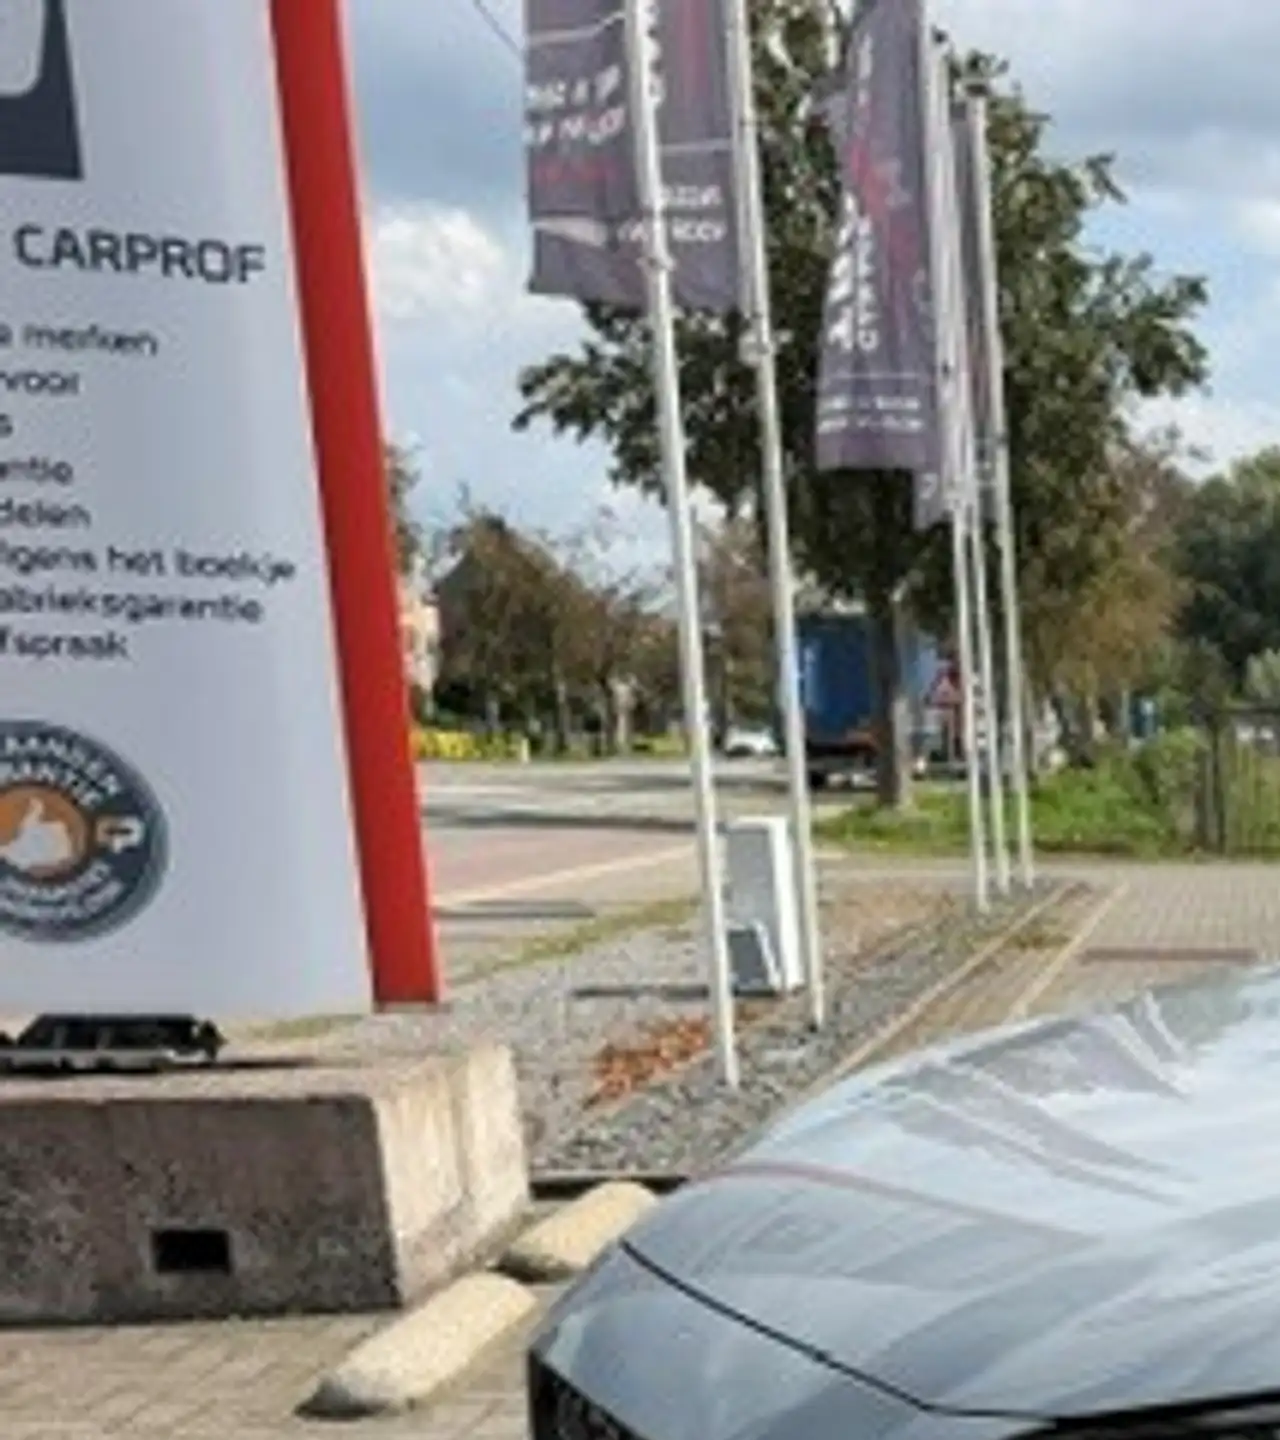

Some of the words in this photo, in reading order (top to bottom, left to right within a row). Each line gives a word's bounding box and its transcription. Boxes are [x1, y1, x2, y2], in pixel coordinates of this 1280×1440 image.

[13, 223, 267, 284] CARPROF
[23, 322, 159, 357] merken
[107, 545, 166, 576] het
[176, 549, 297, 586] boekje
